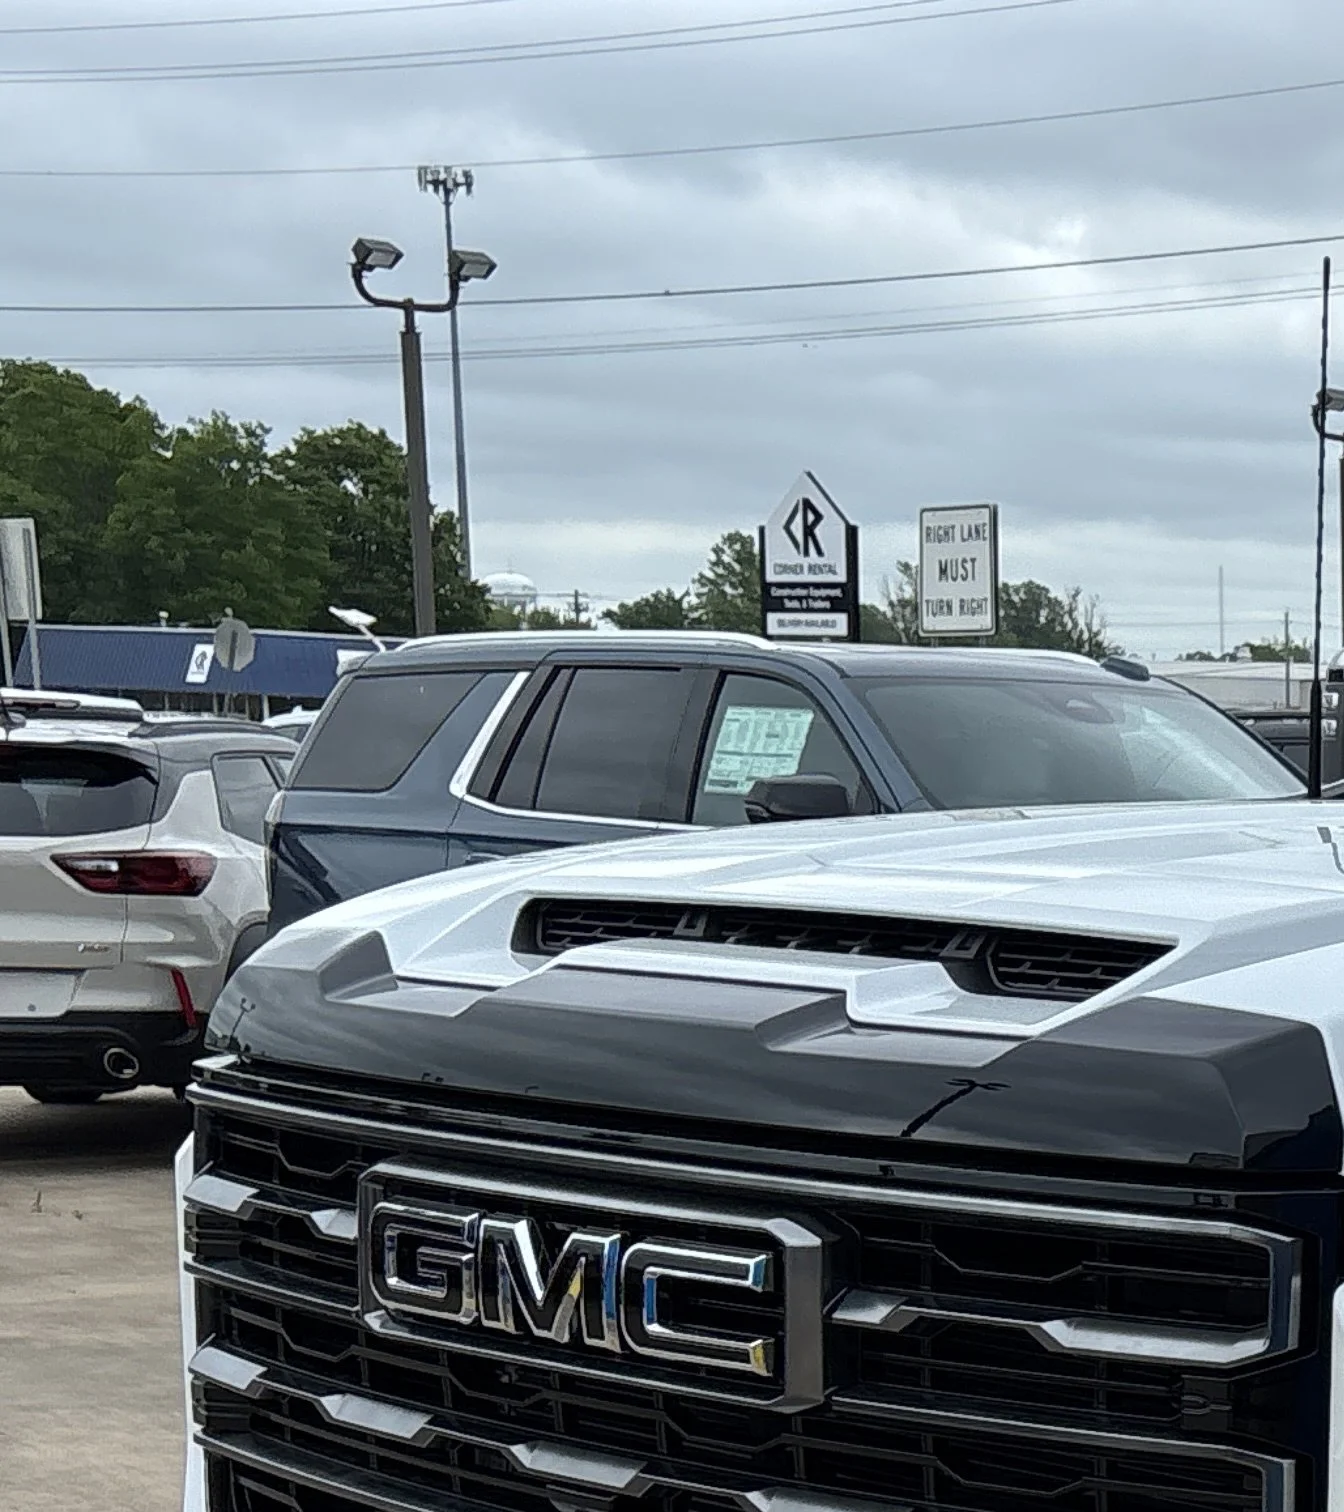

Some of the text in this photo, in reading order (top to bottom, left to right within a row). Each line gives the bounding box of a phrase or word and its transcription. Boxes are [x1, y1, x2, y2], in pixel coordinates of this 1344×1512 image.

[925, 523, 988, 544] RIGHT LANE
[938, 557, 977, 582] MUST
[925, 597, 988, 617] TURN RIGHT
[369, 1201, 774, 1378] GMC
